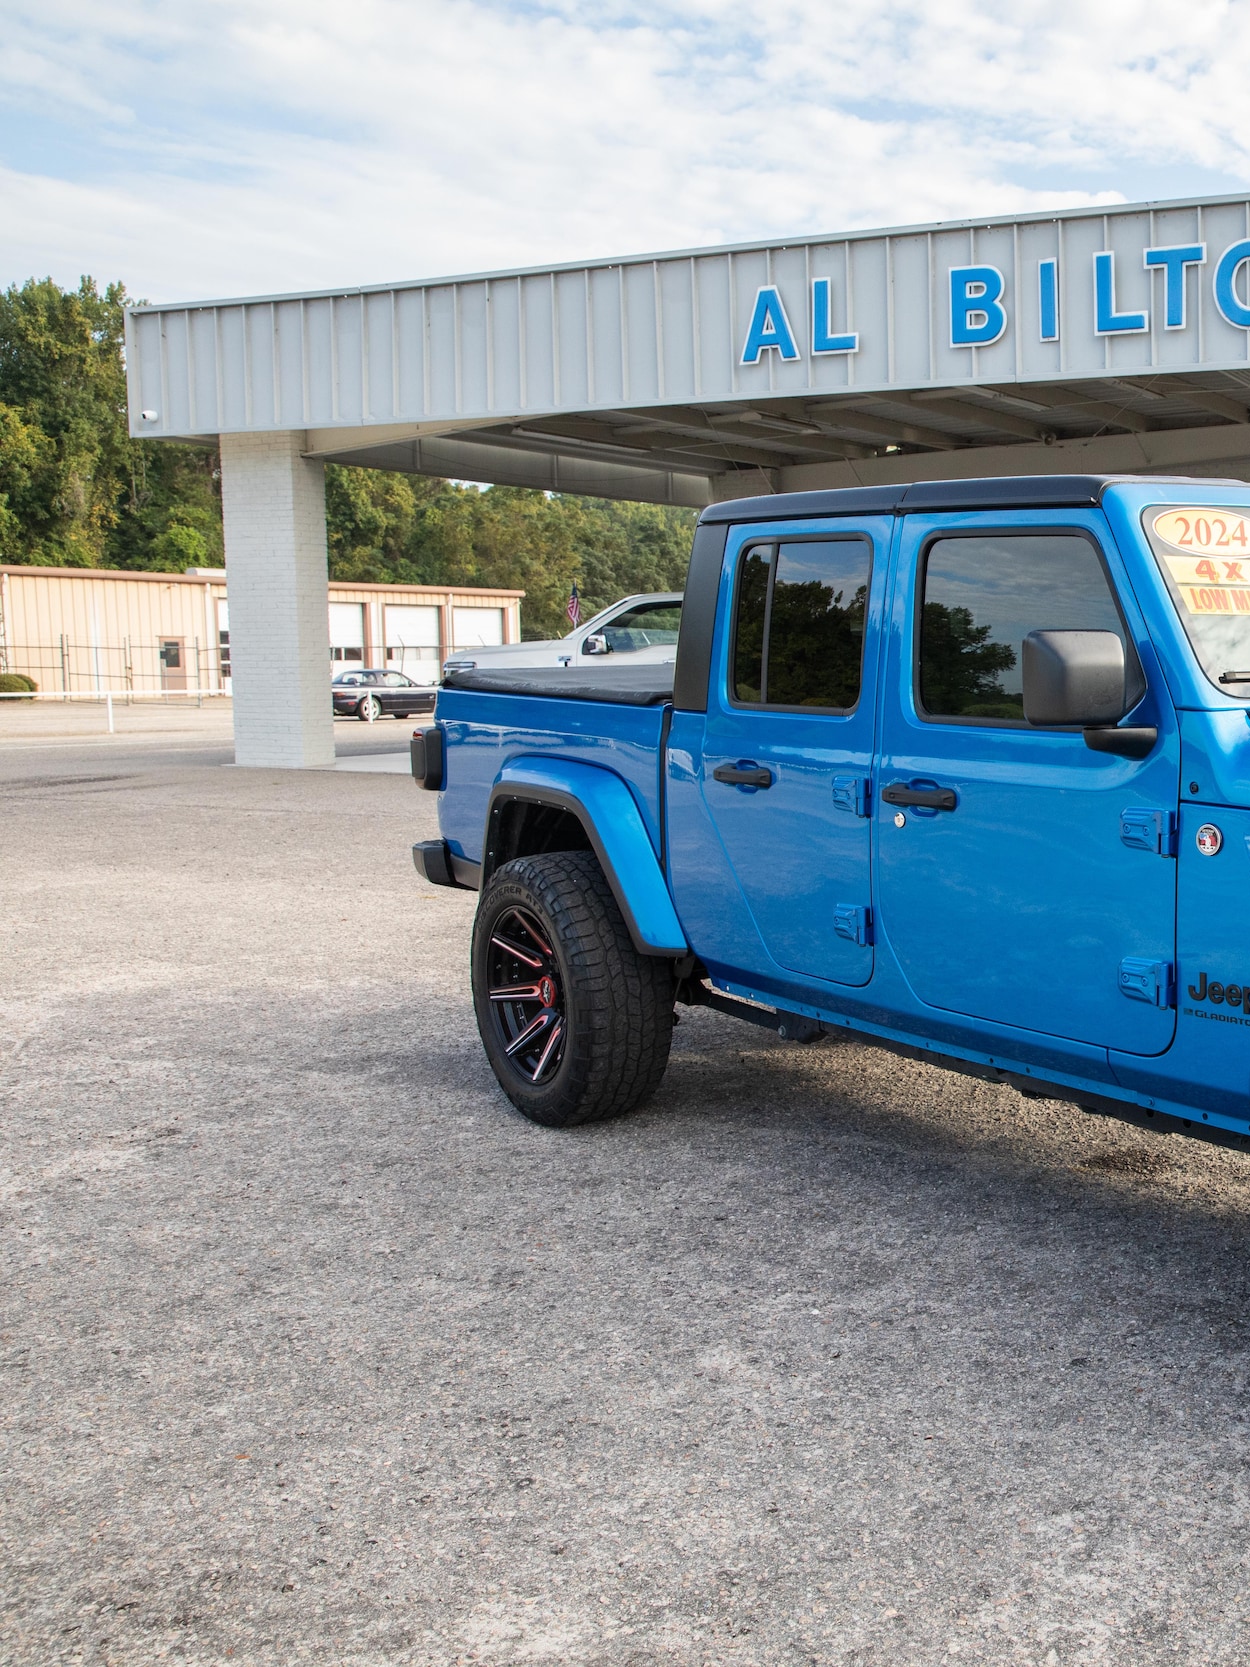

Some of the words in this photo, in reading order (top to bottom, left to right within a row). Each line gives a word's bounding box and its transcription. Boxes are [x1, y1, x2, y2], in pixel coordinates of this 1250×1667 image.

[739, 277, 860, 365] AL
[1174, 517, 1248, 547] 2024
[1189, 588, 1233, 614] LOW
